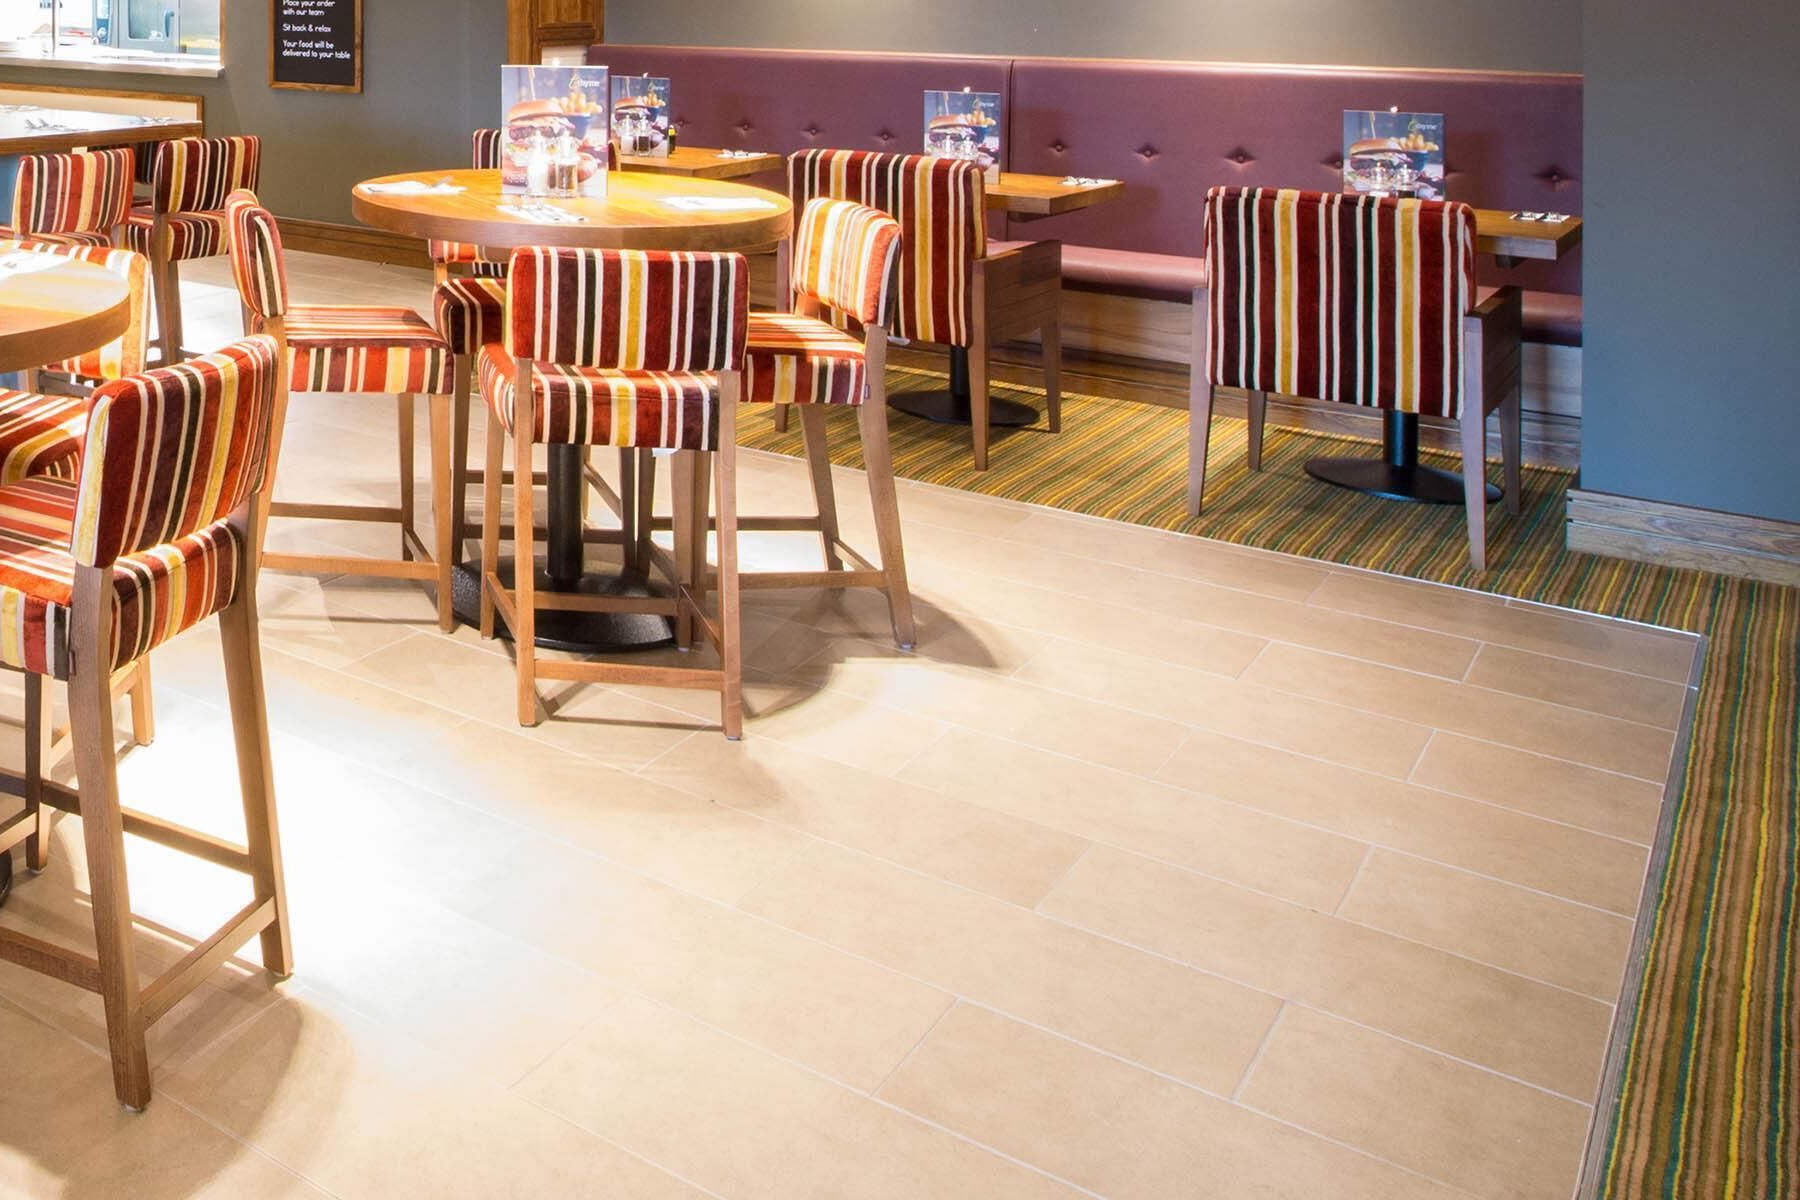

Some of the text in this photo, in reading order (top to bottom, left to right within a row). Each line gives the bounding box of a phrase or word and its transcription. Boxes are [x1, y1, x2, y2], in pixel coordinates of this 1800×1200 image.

[301, 0, 315, 8] your
[316, 0, 335, 7] order
[283, 23, 331, 32] Sit back & relax
[283, 40, 334, 49] Your food will be
[283, 49, 310, 58] delivered
[312, 50, 318, 58] to
[335, 50, 351, 59] table
